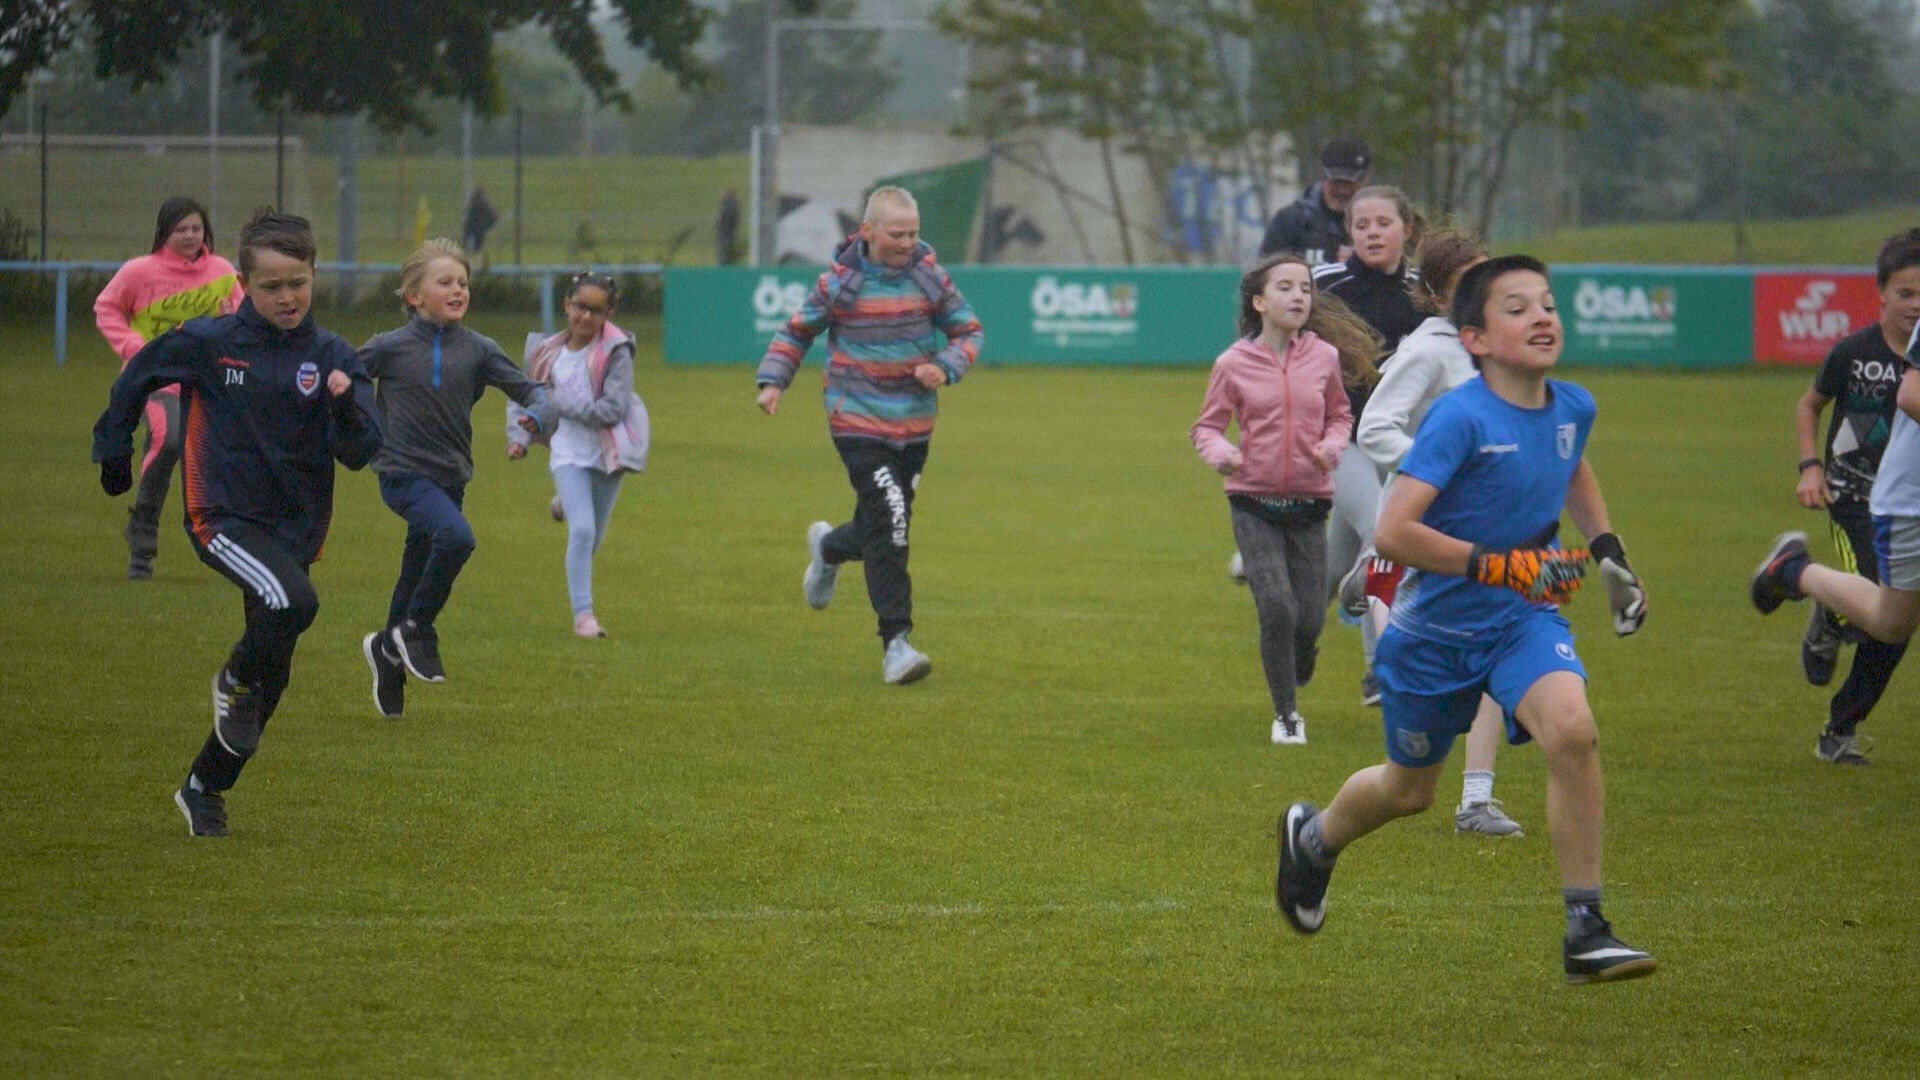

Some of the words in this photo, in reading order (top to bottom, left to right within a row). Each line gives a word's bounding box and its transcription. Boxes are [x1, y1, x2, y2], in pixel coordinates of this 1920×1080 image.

[753, 276, 808, 315] ÖS
[1032, 277, 1109, 316] ÖSA
[1574, 280, 1649, 319] ÖSA
[225, 368, 245, 385] JM
[1852, 360, 1904, 382] ROA
[1848, 381, 1887, 400] NYC
